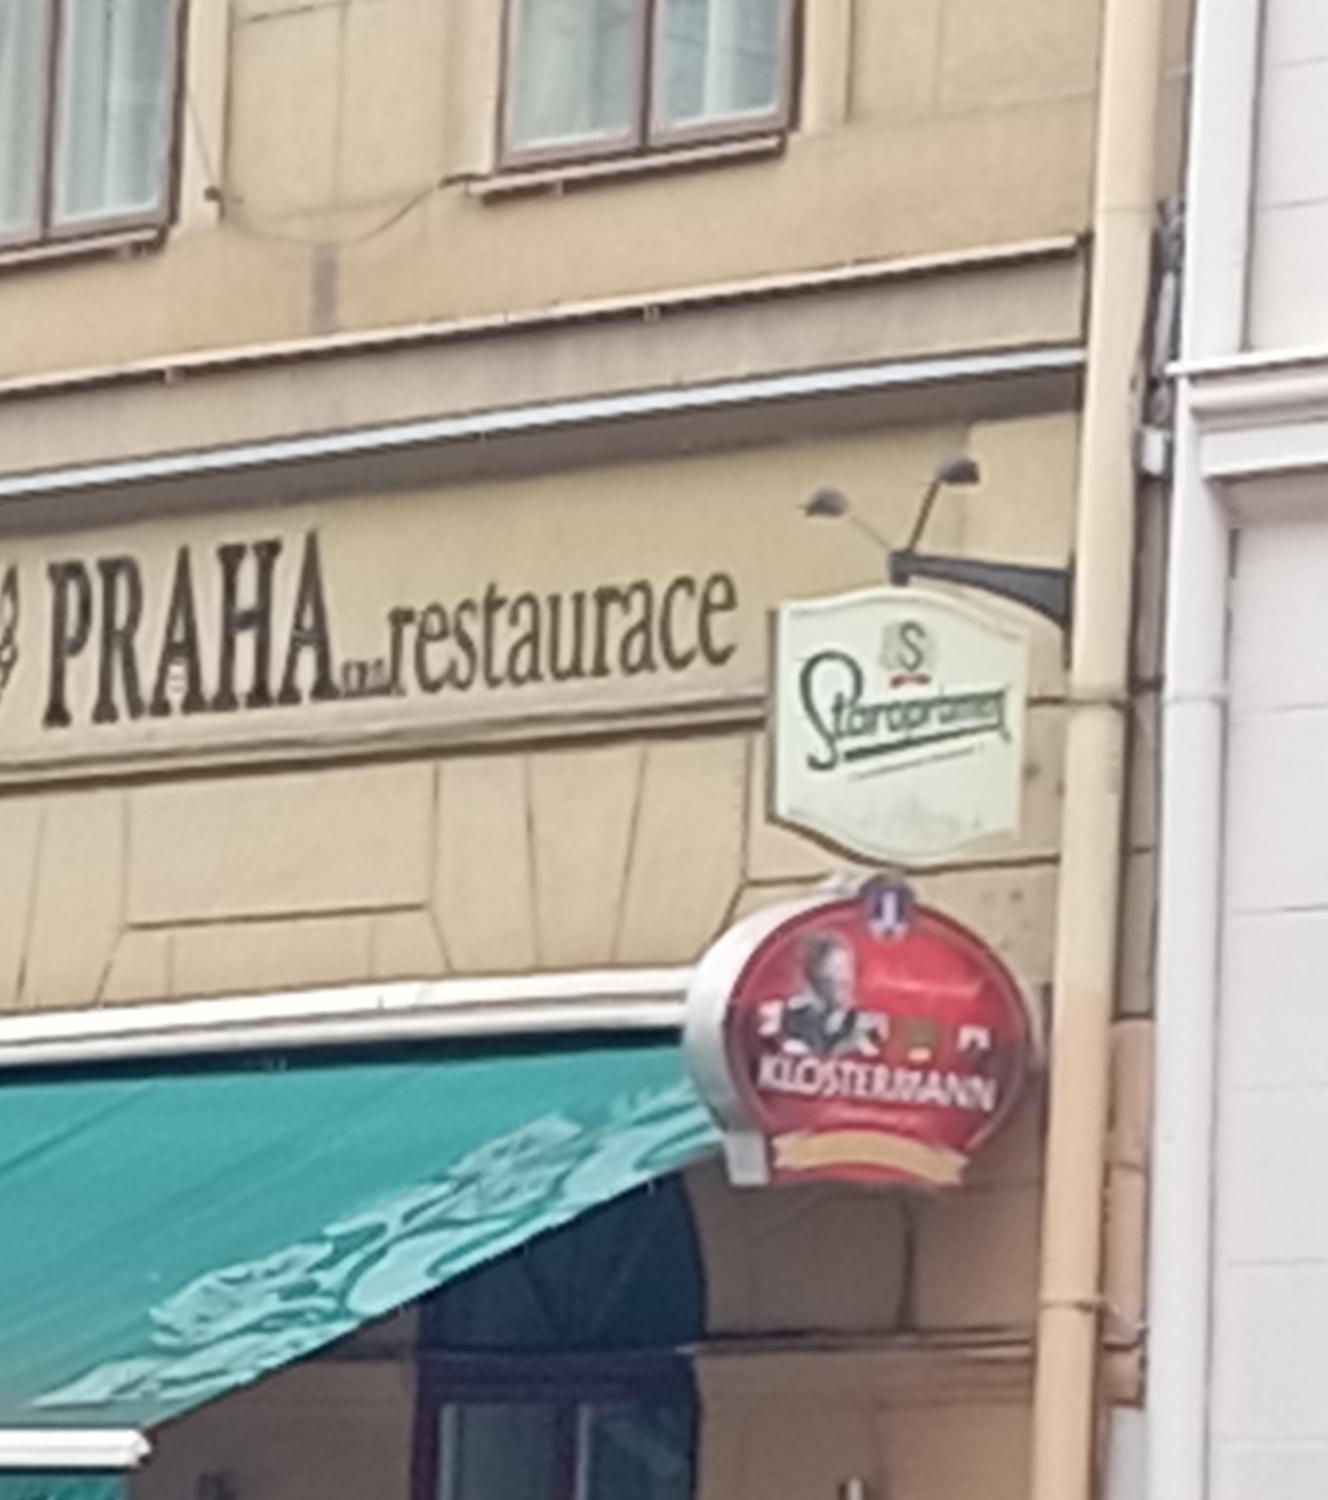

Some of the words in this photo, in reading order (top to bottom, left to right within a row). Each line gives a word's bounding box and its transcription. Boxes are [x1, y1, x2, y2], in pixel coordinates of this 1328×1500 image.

[42, 529, 341, 728] PRAHA
[387, 571, 738, 695] restaurace
[757, 1053, 996, 1112] KLOSTERMANN
